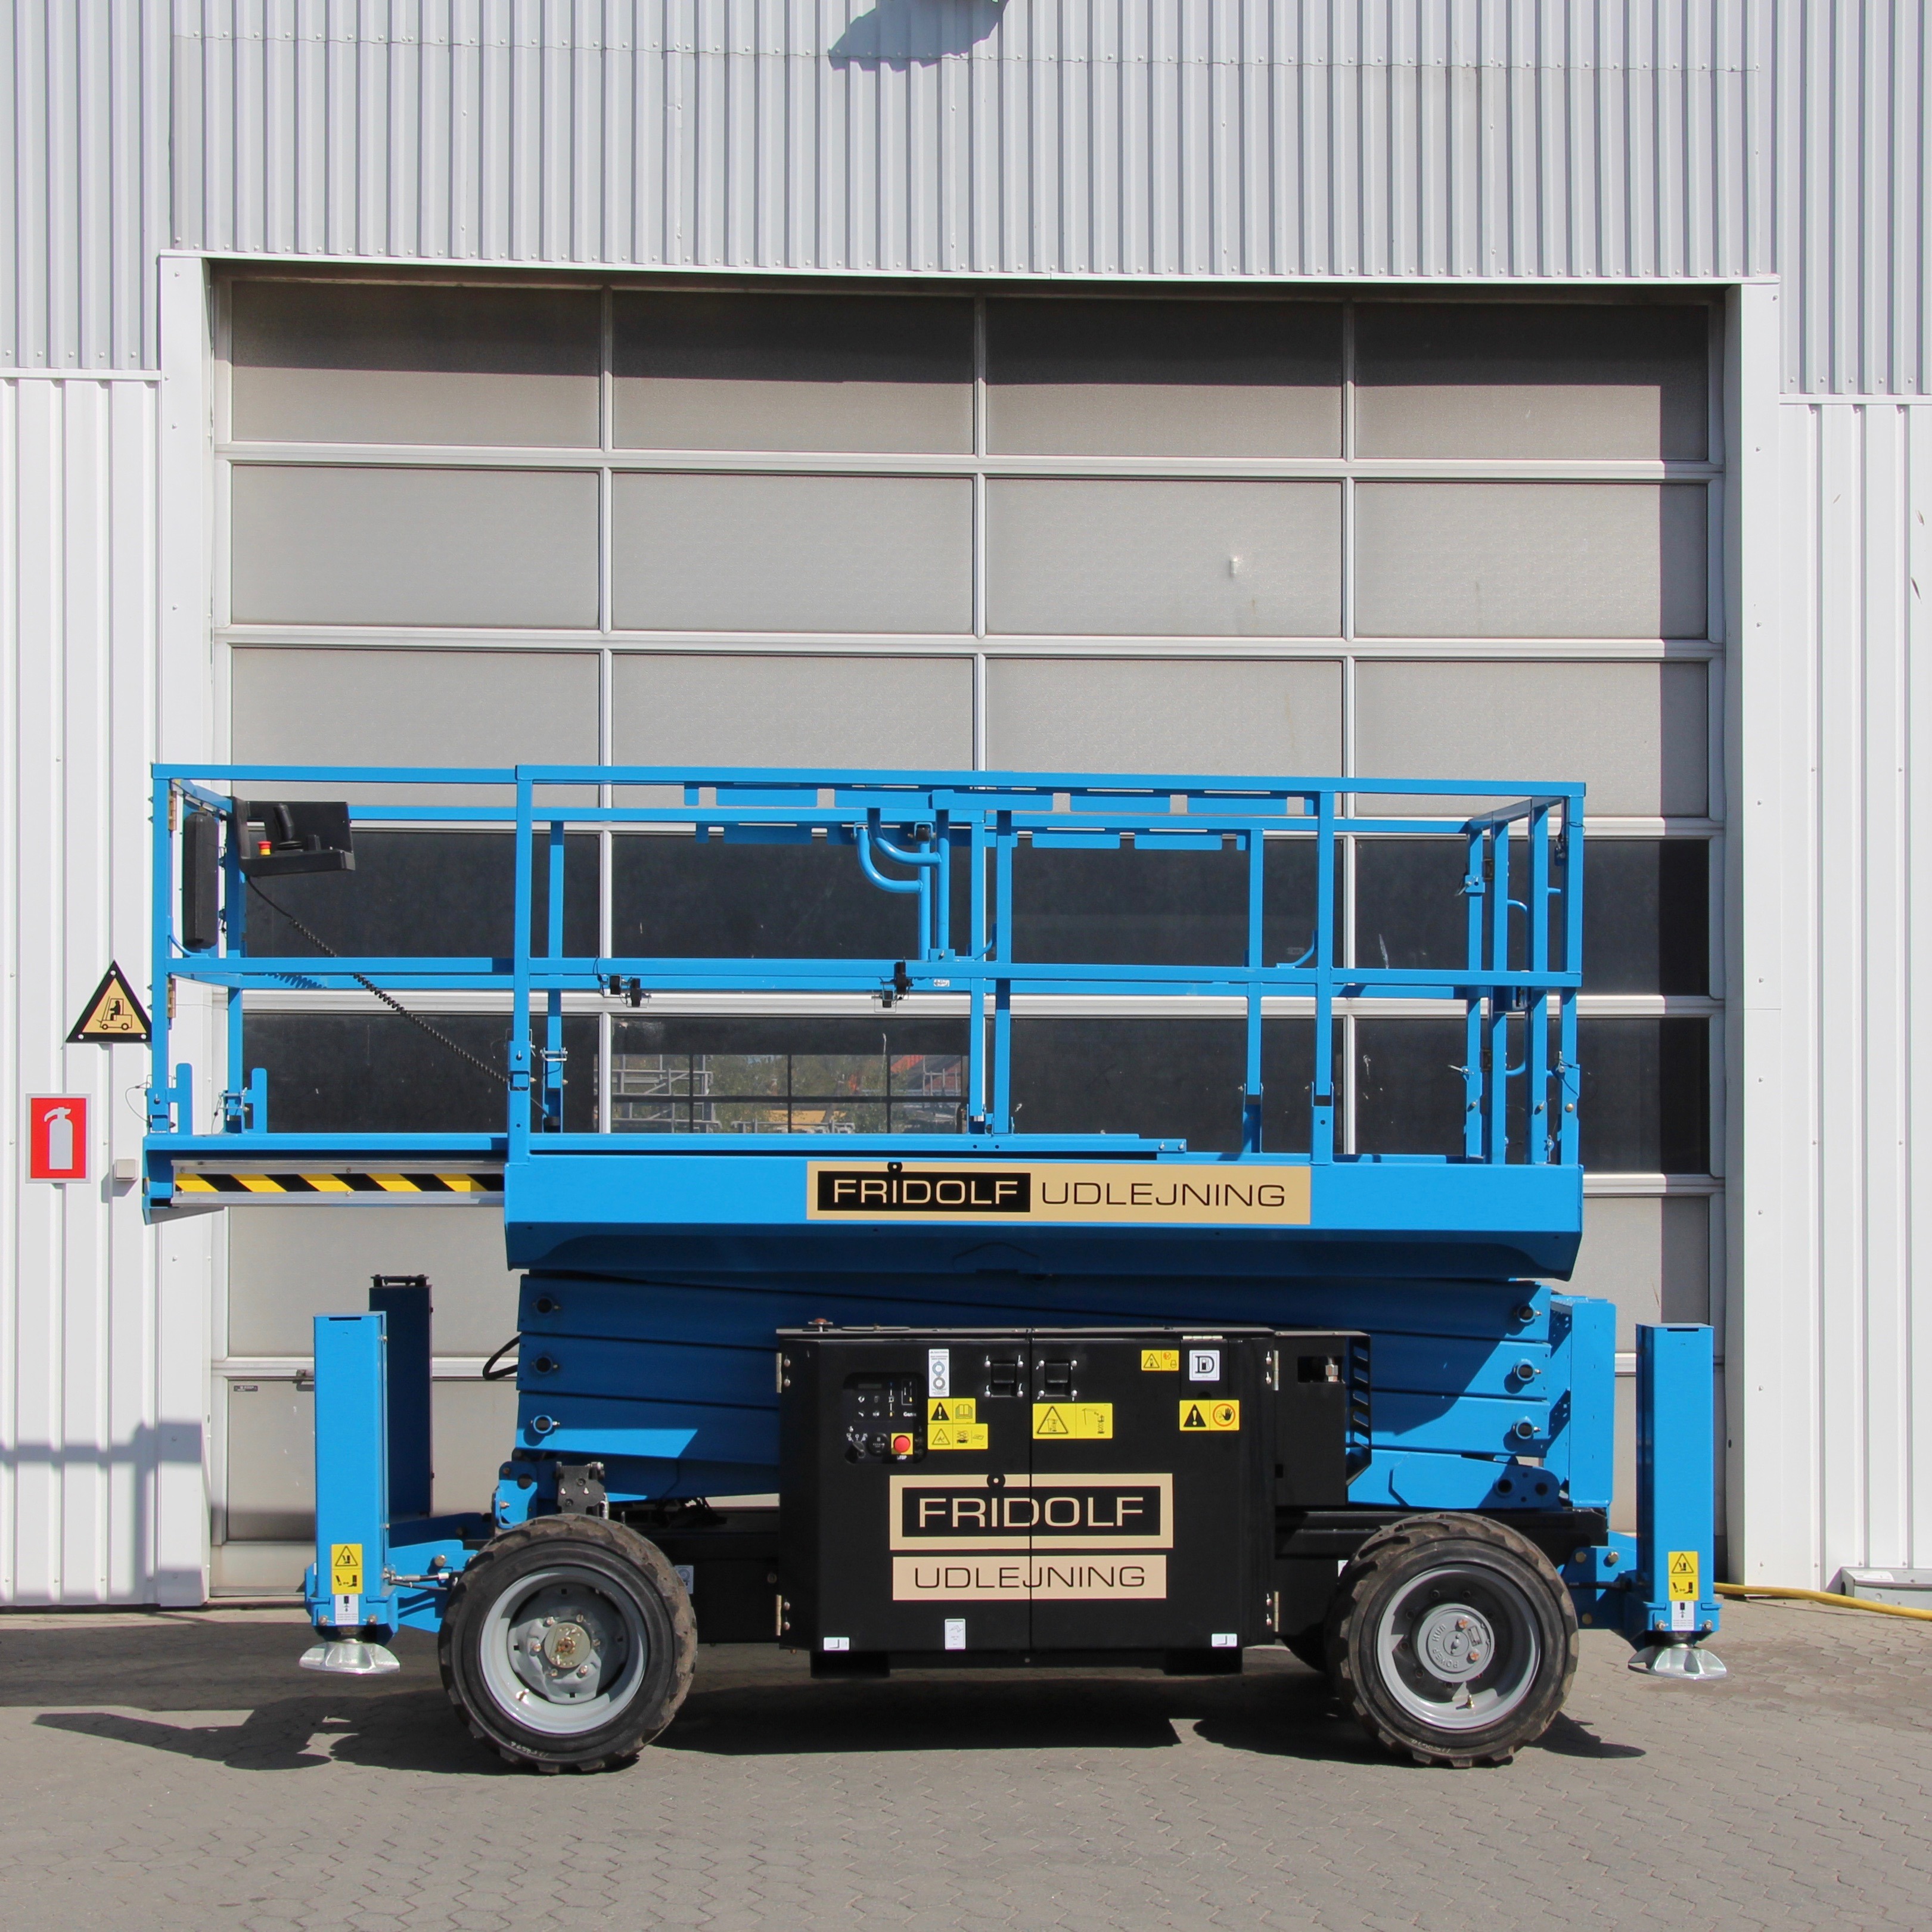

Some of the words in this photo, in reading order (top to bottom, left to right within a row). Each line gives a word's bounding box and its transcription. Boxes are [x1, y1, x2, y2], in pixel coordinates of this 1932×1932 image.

[834, 1179, 1018, 1204] FRIDOLF
[1042, 1182, 1285, 1207] UDLEJNING
[919, 1496, 1144, 1527] FRIDOLF
[915, 1566, 1145, 1589] UDLEJNING
